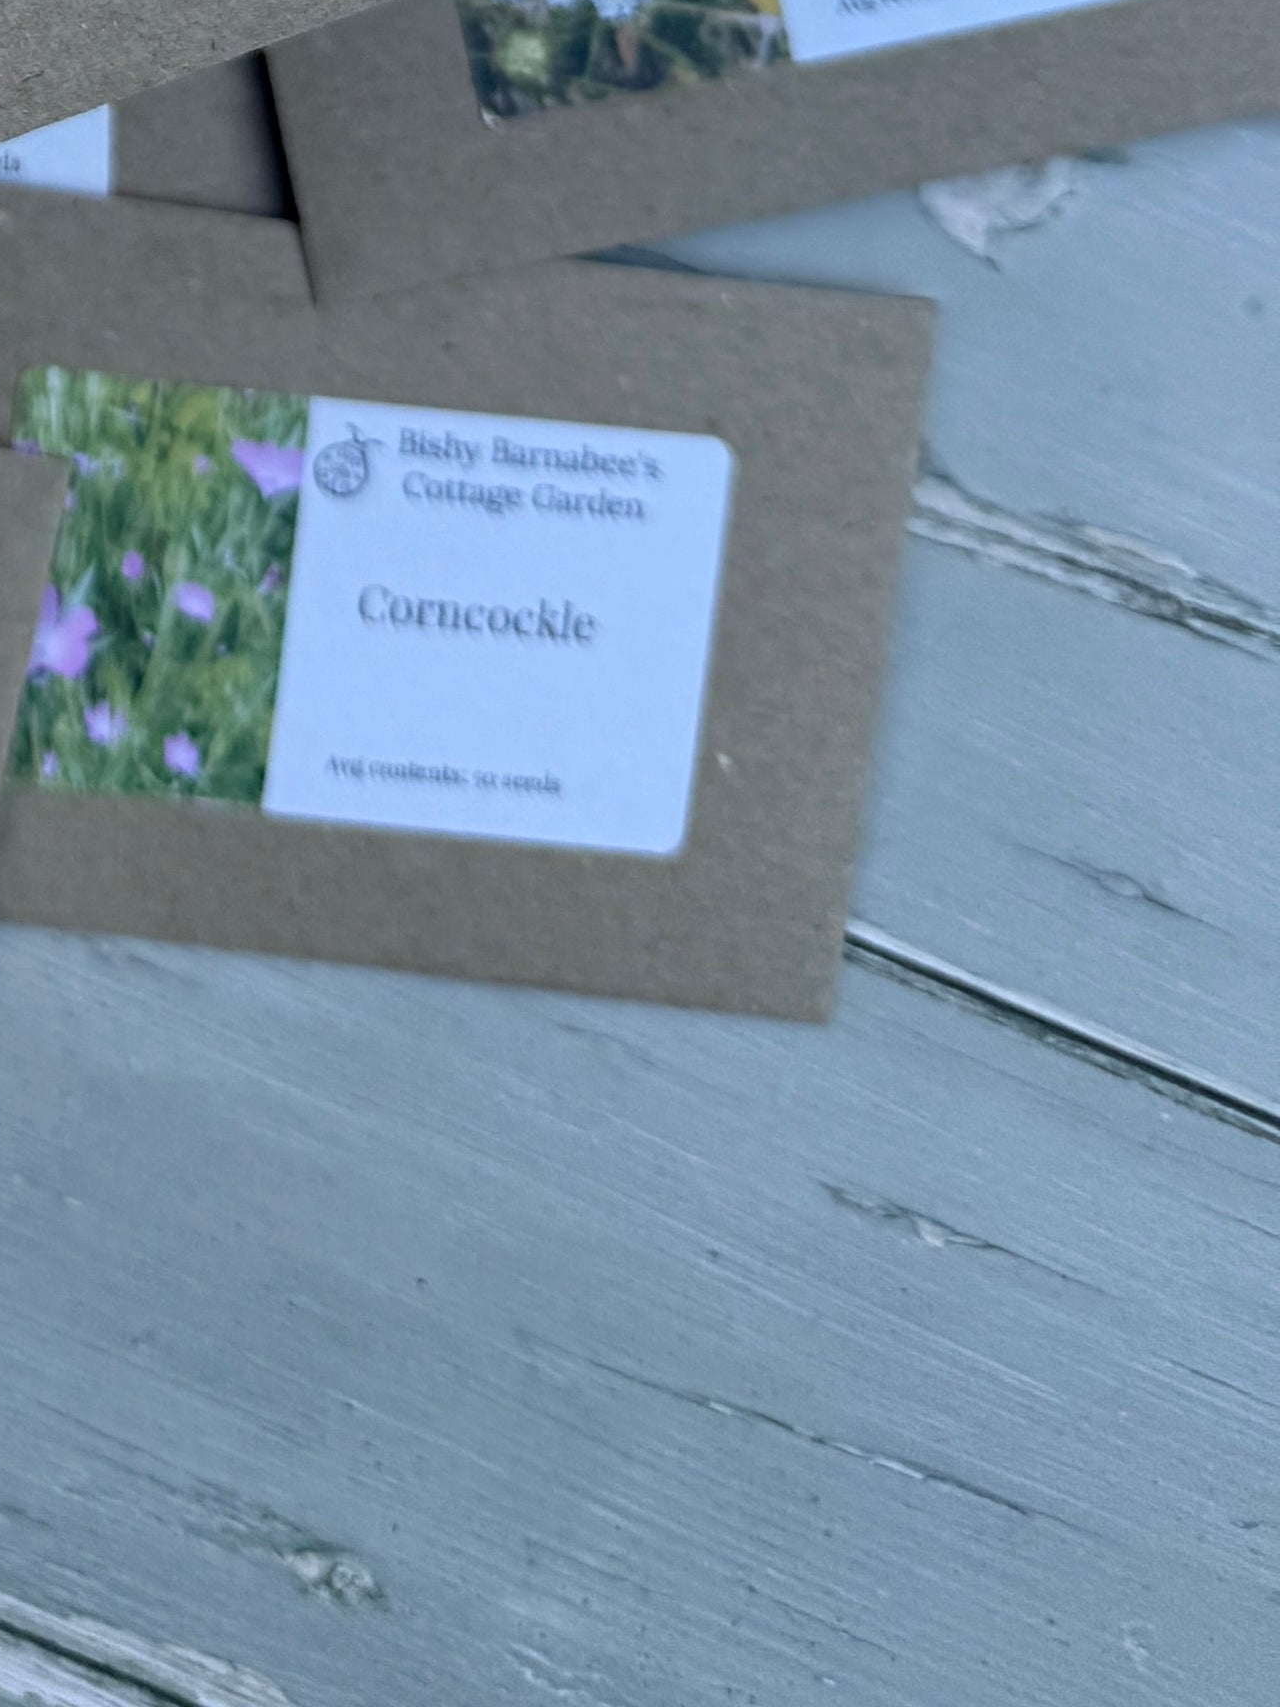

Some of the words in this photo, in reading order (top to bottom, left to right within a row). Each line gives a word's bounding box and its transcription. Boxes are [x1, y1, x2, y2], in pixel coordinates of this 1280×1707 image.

[399, 427, 481, 465] Bishy
[491, 434, 664, 481] Barnabee's
[402, 471, 524, 514] Cottage
[533, 482, 644, 521] Garden
[358, 585, 597, 644] Corncockle
